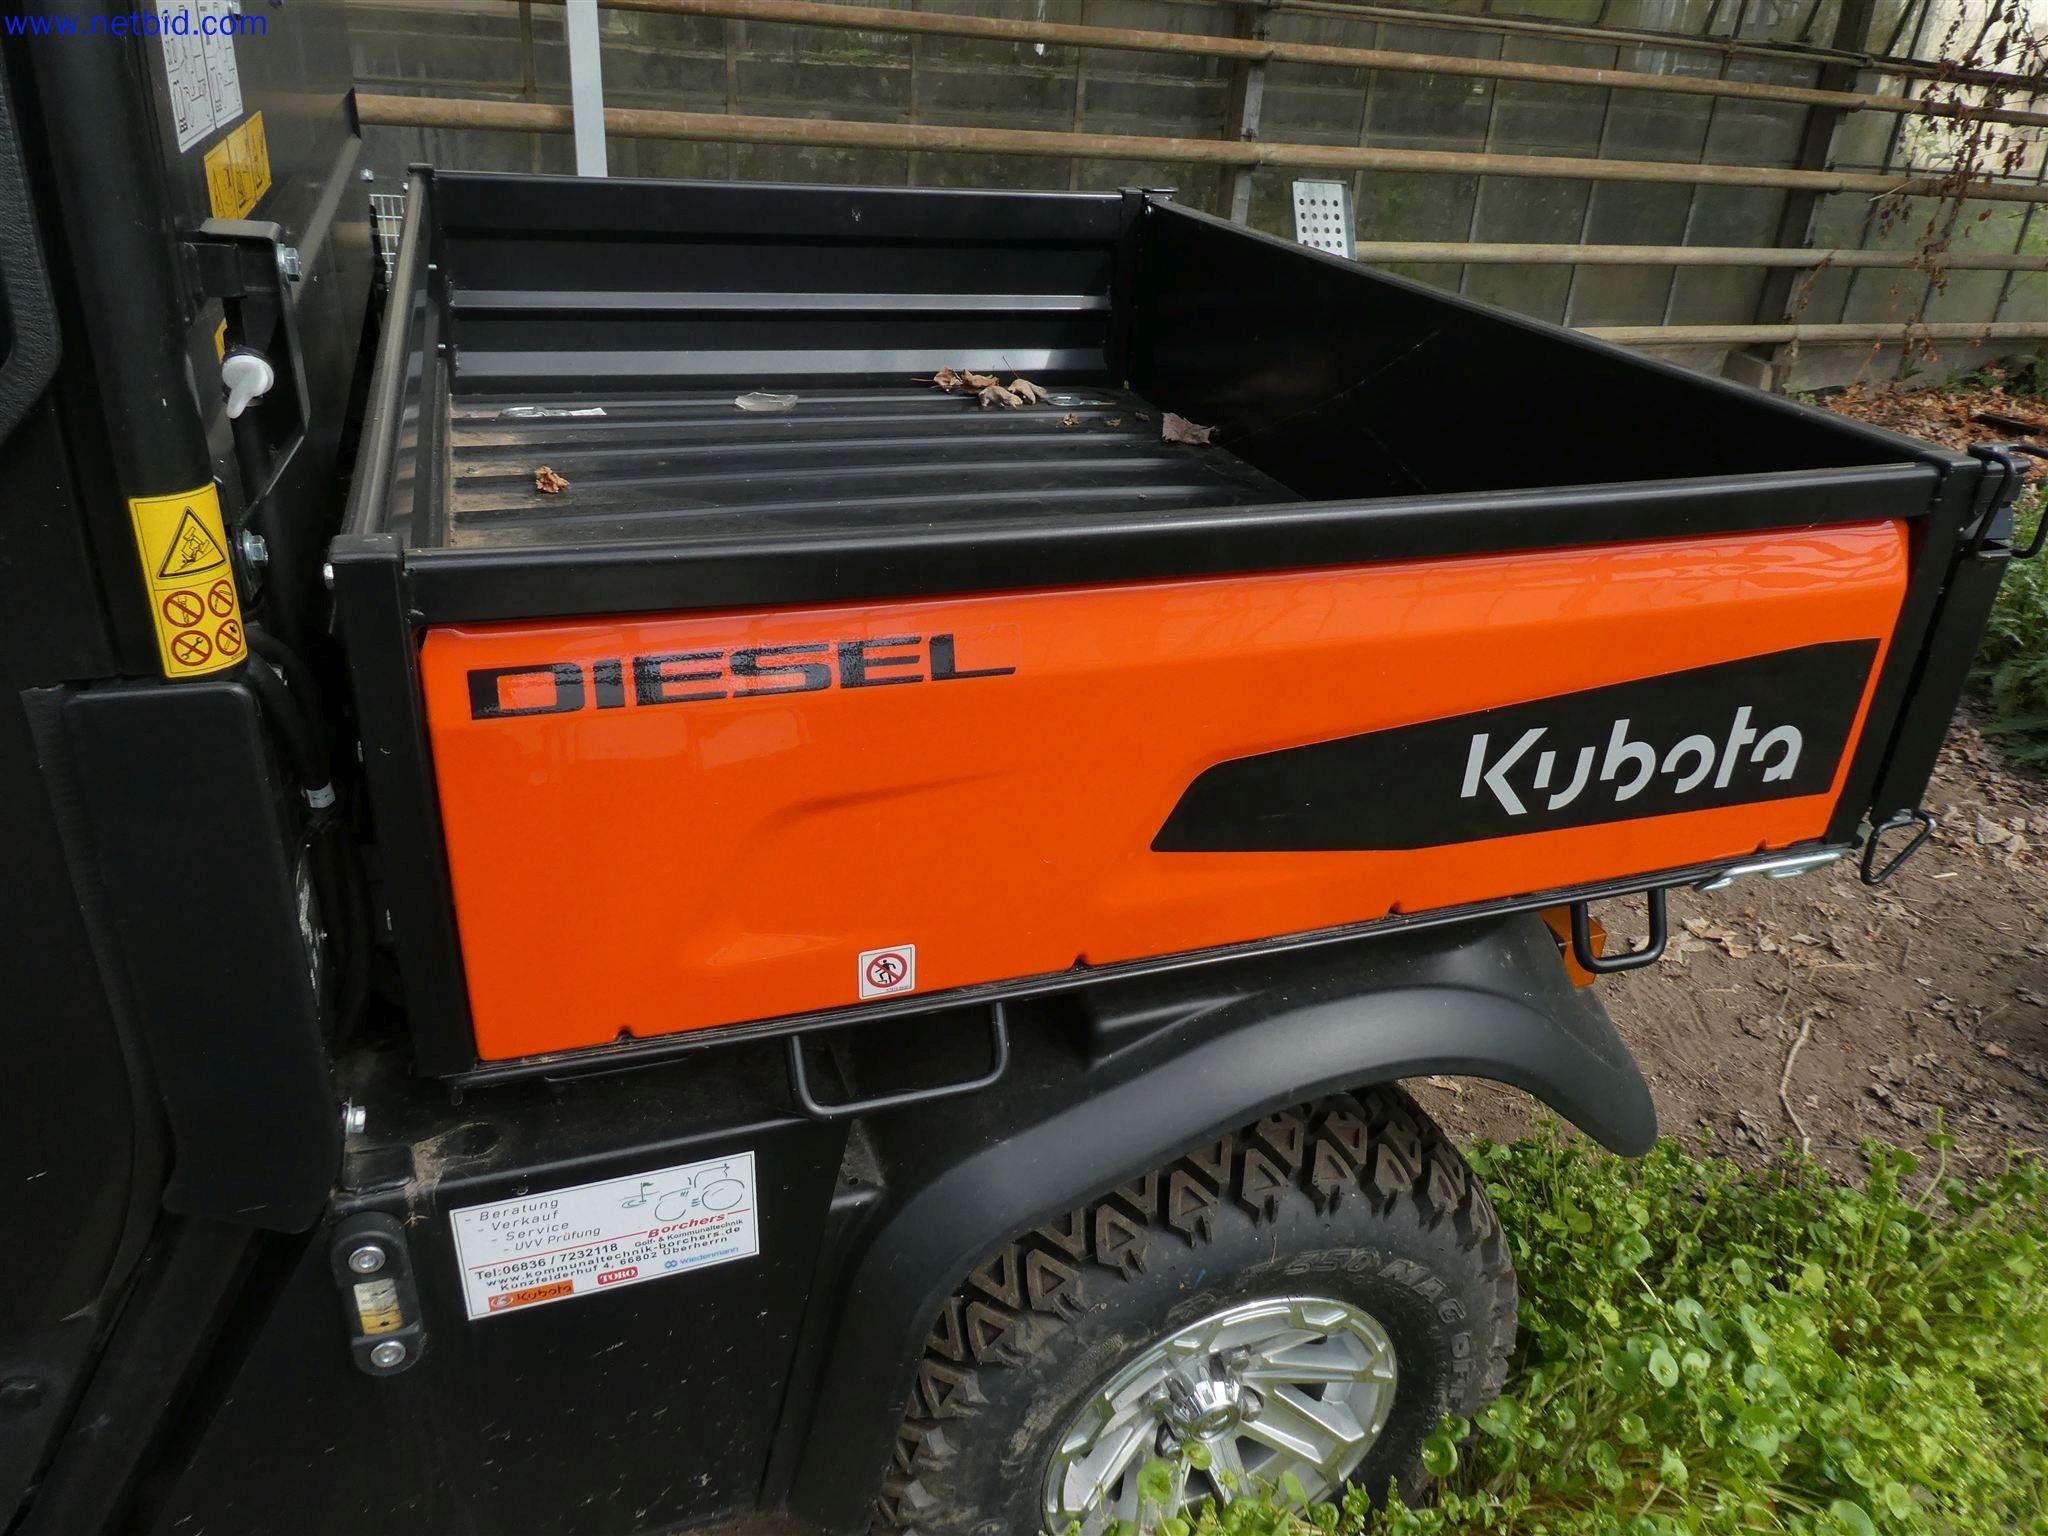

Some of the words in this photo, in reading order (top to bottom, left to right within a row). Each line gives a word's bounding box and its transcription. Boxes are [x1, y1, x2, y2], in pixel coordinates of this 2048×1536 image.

[467, 634, 1016, 720] DIESEL
[1460, 706, 1802, 815] Kubota
[480, 1199, 559, 1221] Beratung
[492, 1210, 559, 1231] Verkauf
[506, 1222, 569, 1241] Service
[648, 1213, 725, 1238] Borchers
[667, 1219, 743, 1240] Kommunaltechnik
[515, 1238, 543, 1251] UVV
[547, 1227, 601, 1244] Prüfung
[486, 1226, 741, 1286] www.kommunaltechnik-borchers.de
[559, 1243, 618, 1263] 7232118
[620, 1252, 657, 1266] 66802
[599, 1268, 636, 1283] TORO
[516, 1284, 573, 1301] Kubota
